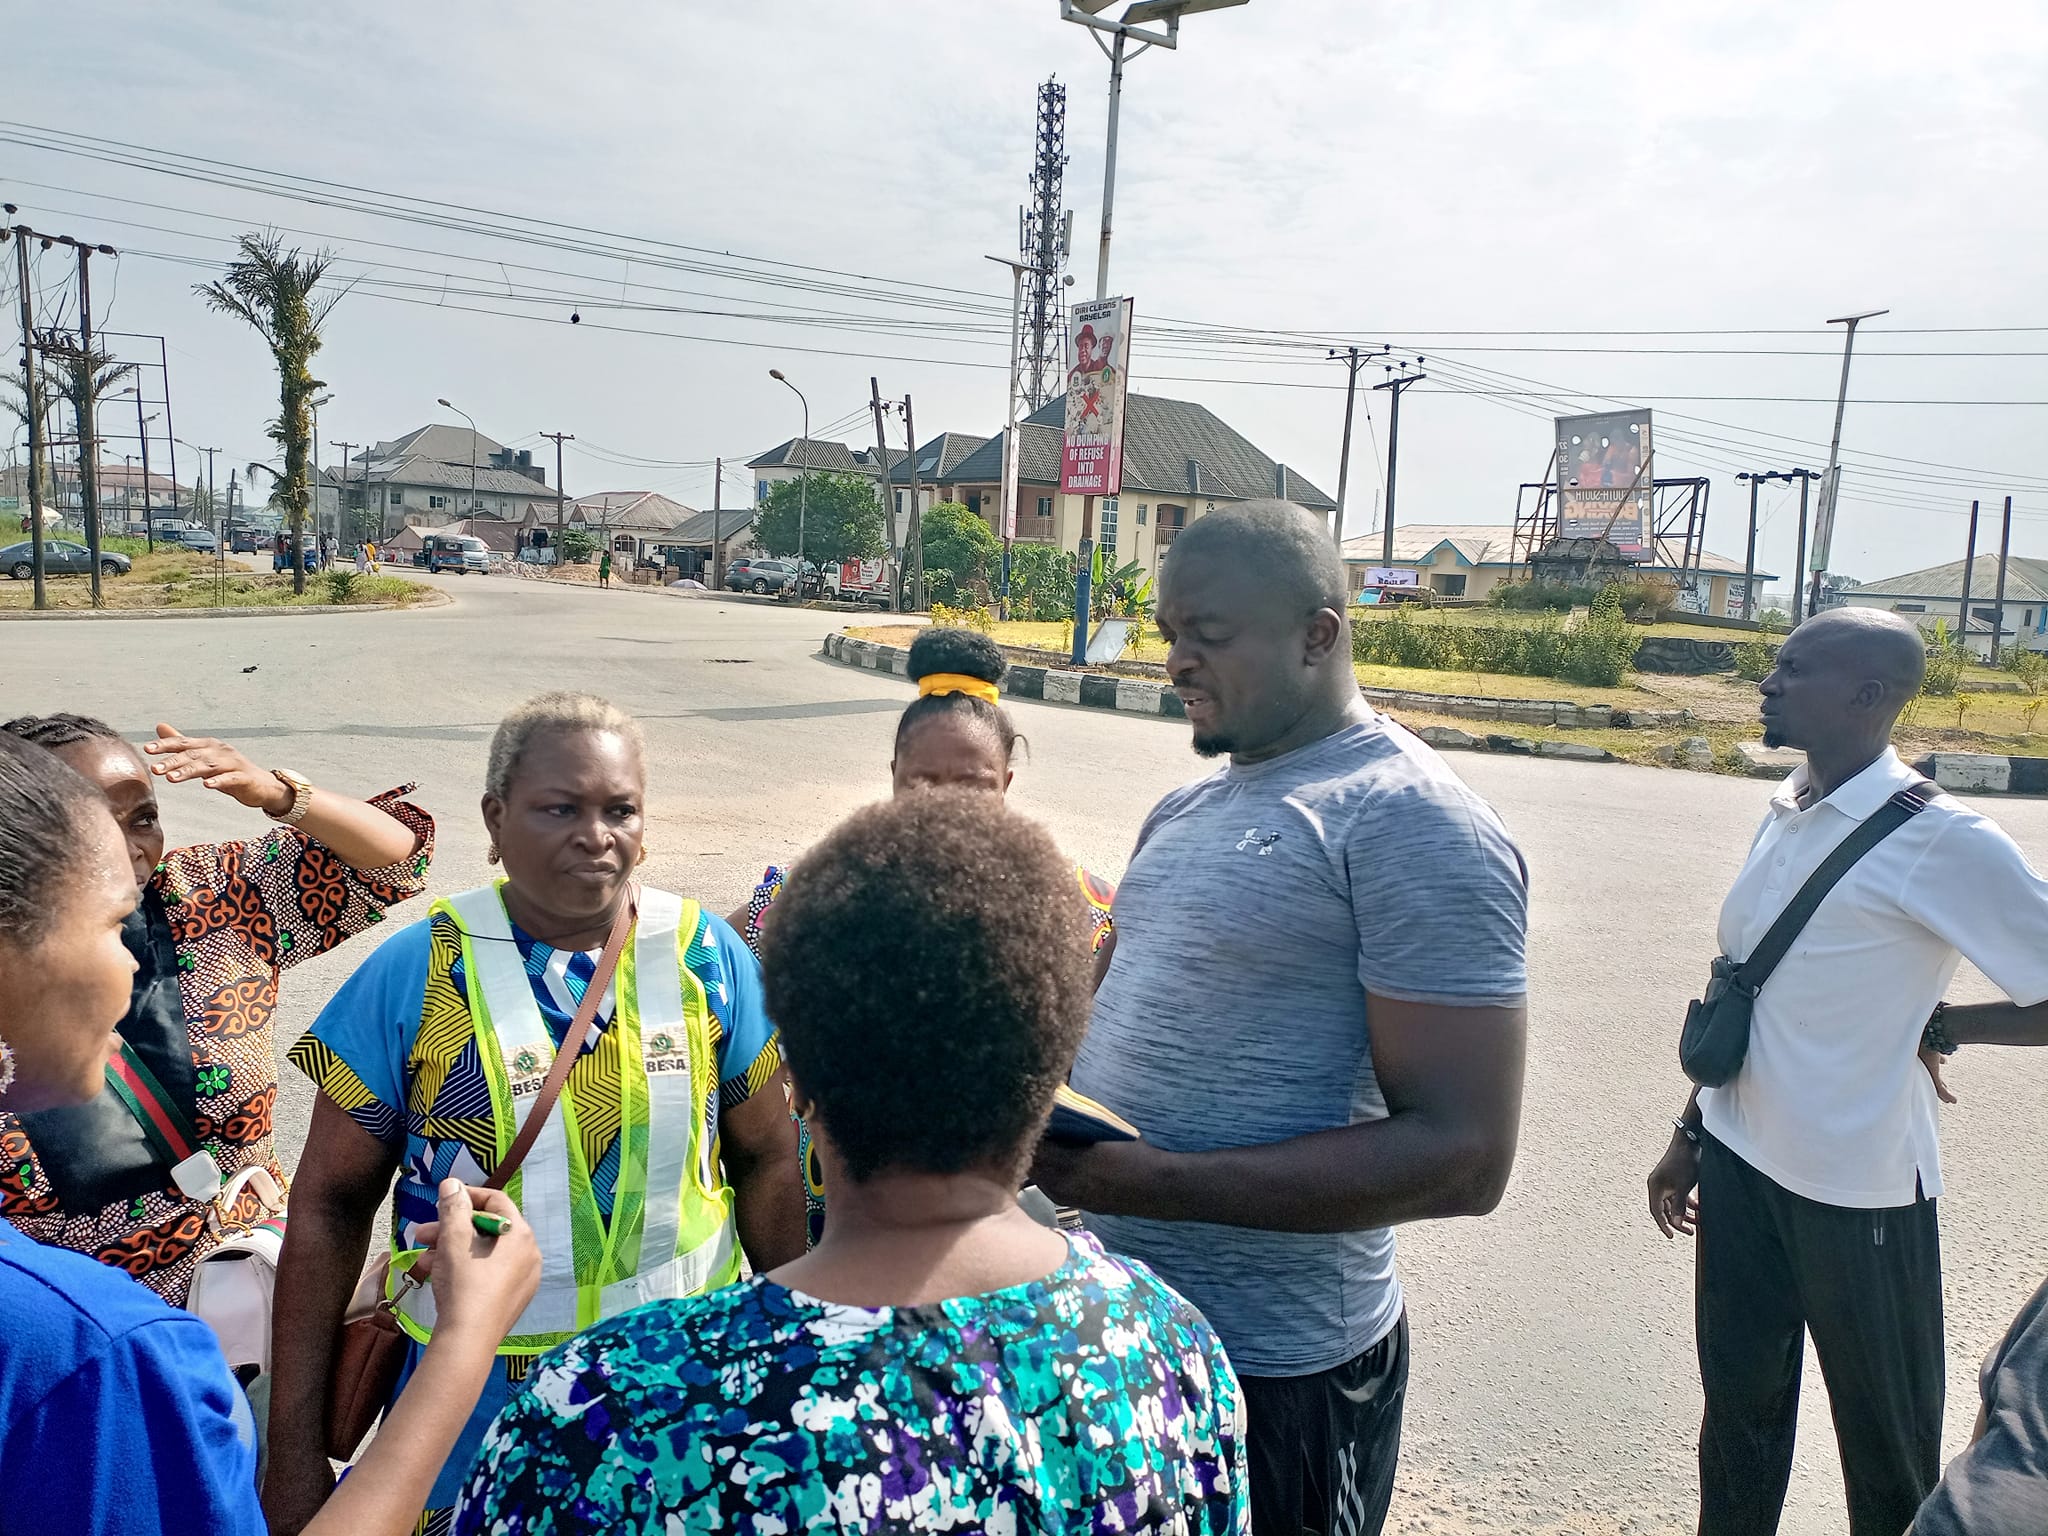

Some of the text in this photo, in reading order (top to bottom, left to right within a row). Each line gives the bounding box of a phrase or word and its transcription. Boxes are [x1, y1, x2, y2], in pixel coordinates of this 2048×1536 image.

[1074, 302, 1116, 315] DIRI CLEANS
[1080, 311, 1111, 322] BAYELSA
[1066, 433, 1109, 448] NO DUMPING
[1069, 447, 1104, 460] OF REFUSE
[1078, 462, 1094, 474] INTO
[1068, 475, 1102, 488] DRAINAGE
[646, 1058, 687, 1073] BESA
[511, 1076, 549, 1097] BES
